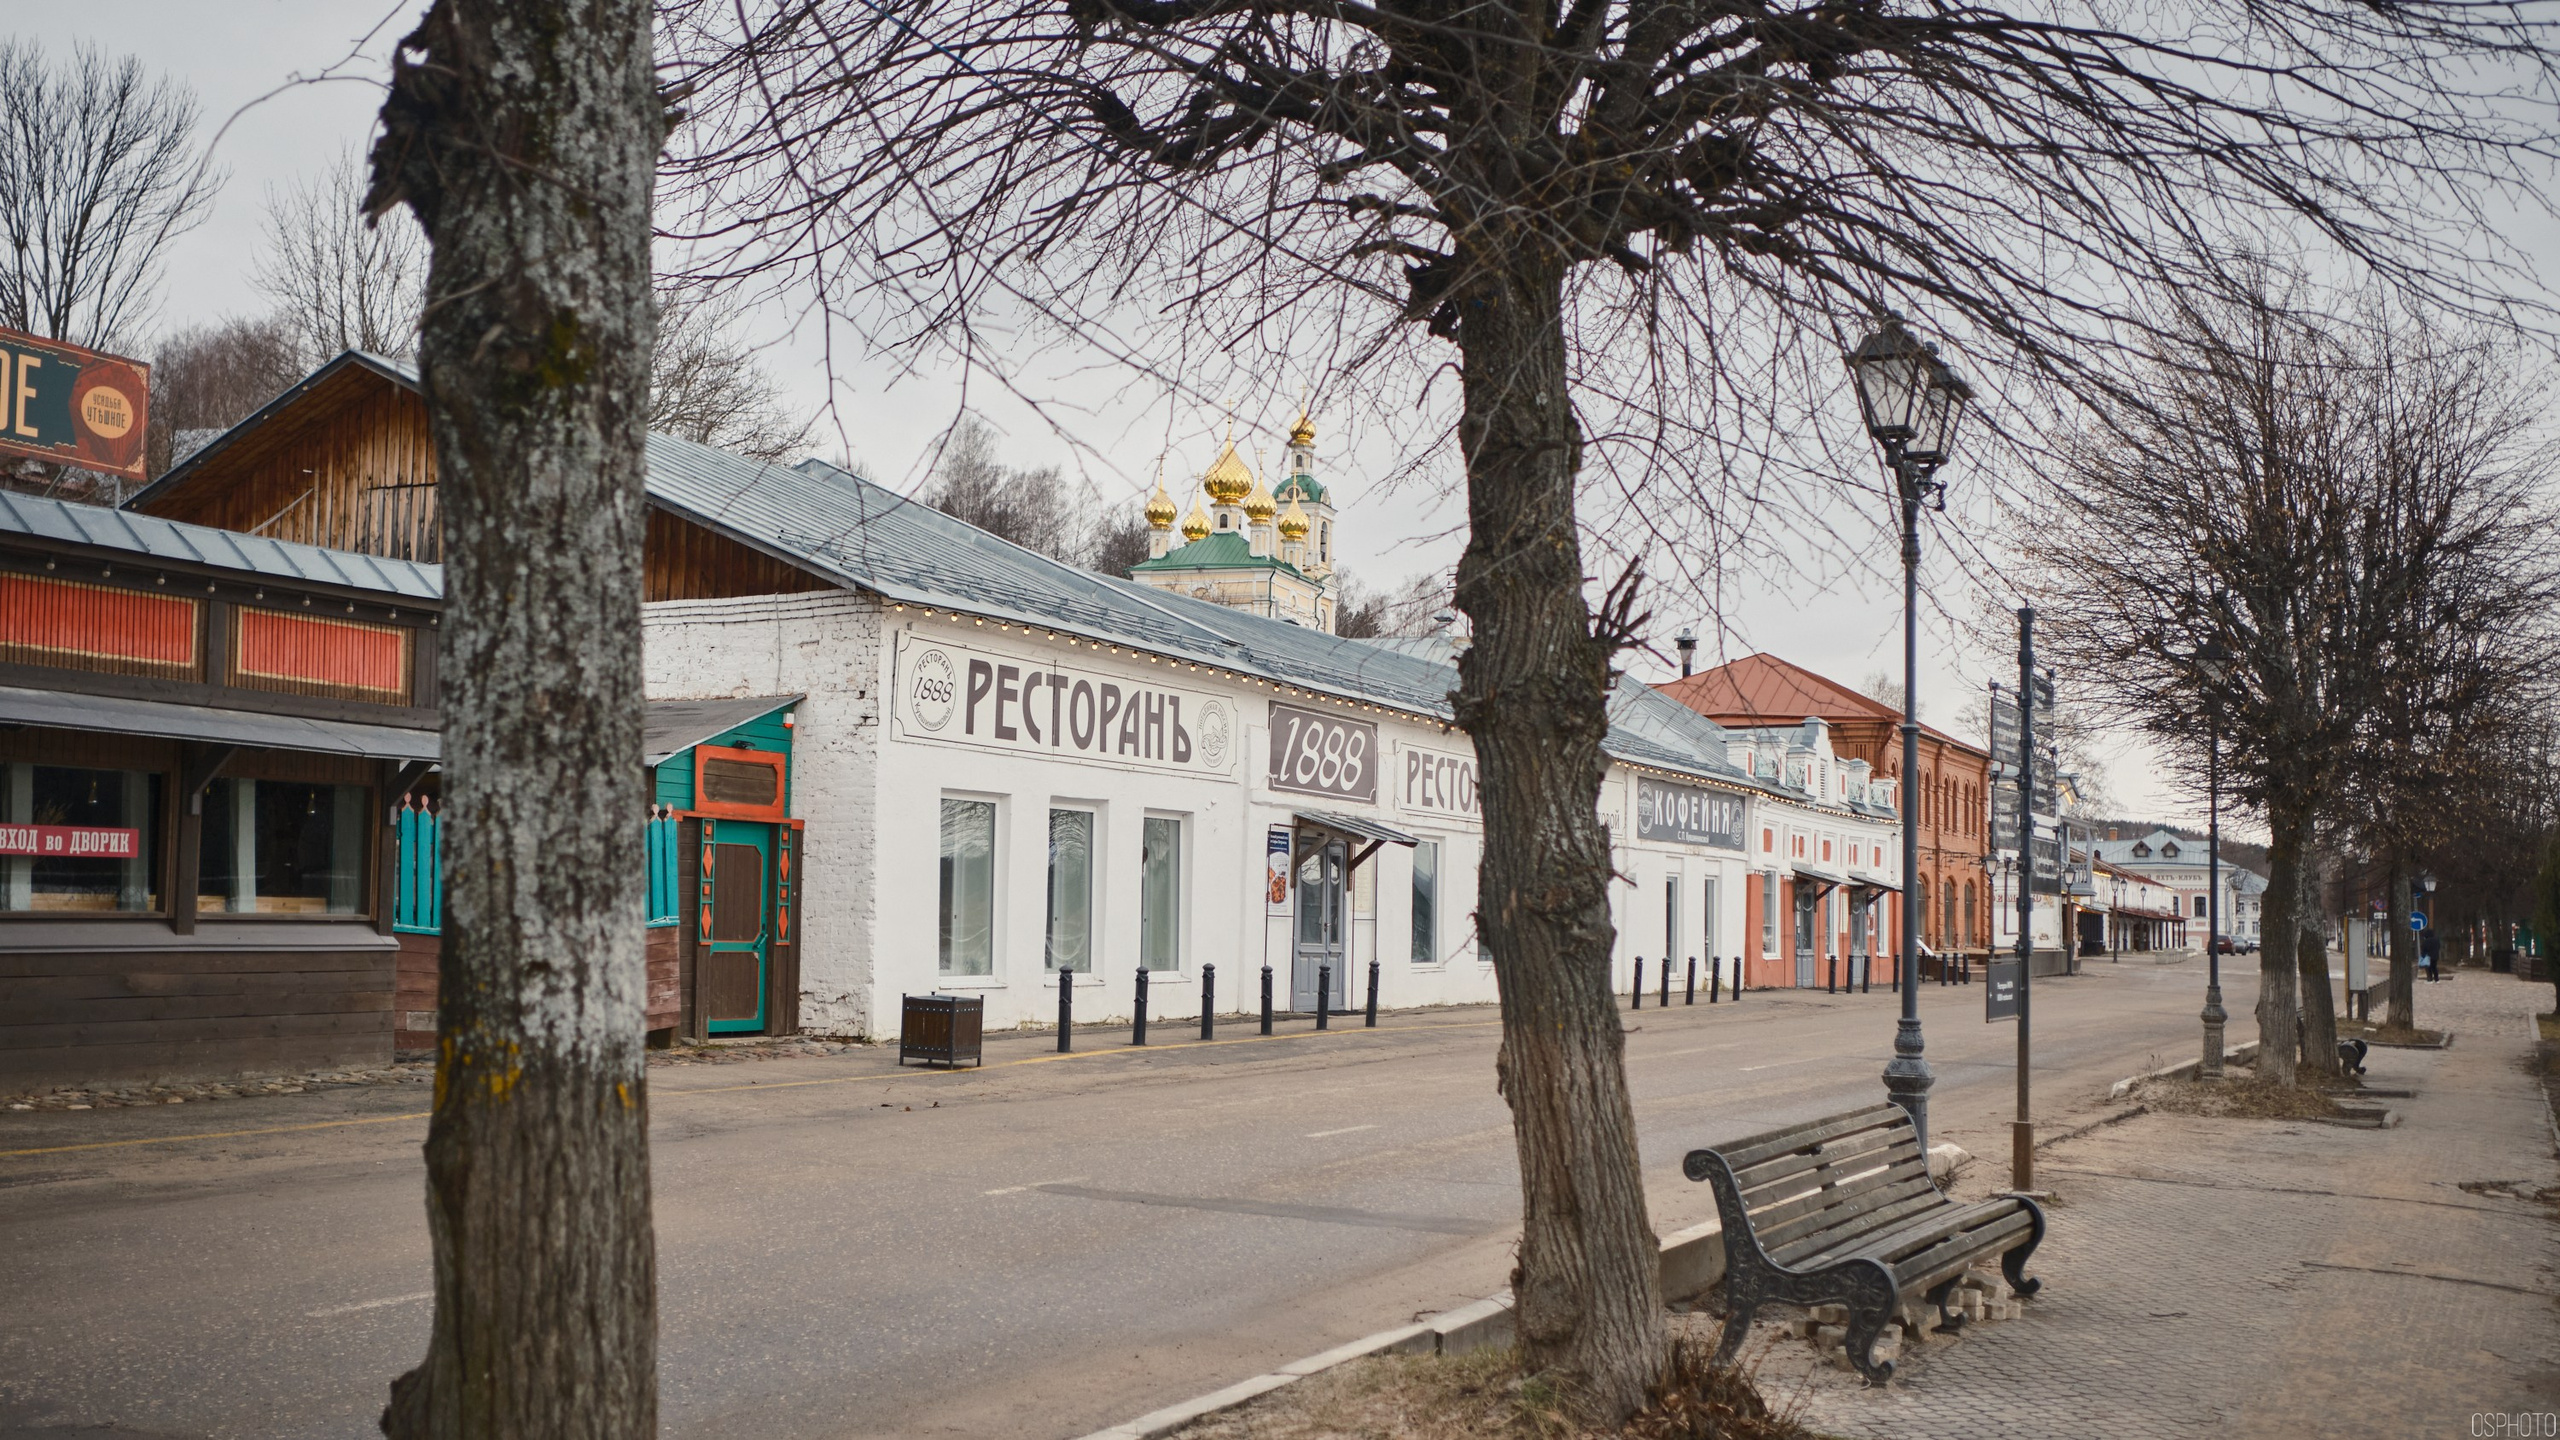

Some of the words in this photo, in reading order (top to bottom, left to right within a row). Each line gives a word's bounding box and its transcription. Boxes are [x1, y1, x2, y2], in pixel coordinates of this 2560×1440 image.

[917, 653, 953, 680] РЕСТОРАНЪ
[913, 676, 954, 703] 1888
[965, 658, 1192, 763] РЕСТОРАНЪ
[1280, 716, 1366, 792] 1888
[1654, 789, 1730, 835] КОФЕЙНЯ
[0, 828, 38, 853] ВХОД
[45, 835, 62, 851] во
[70, 831, 130, 855] ДВОРИК
